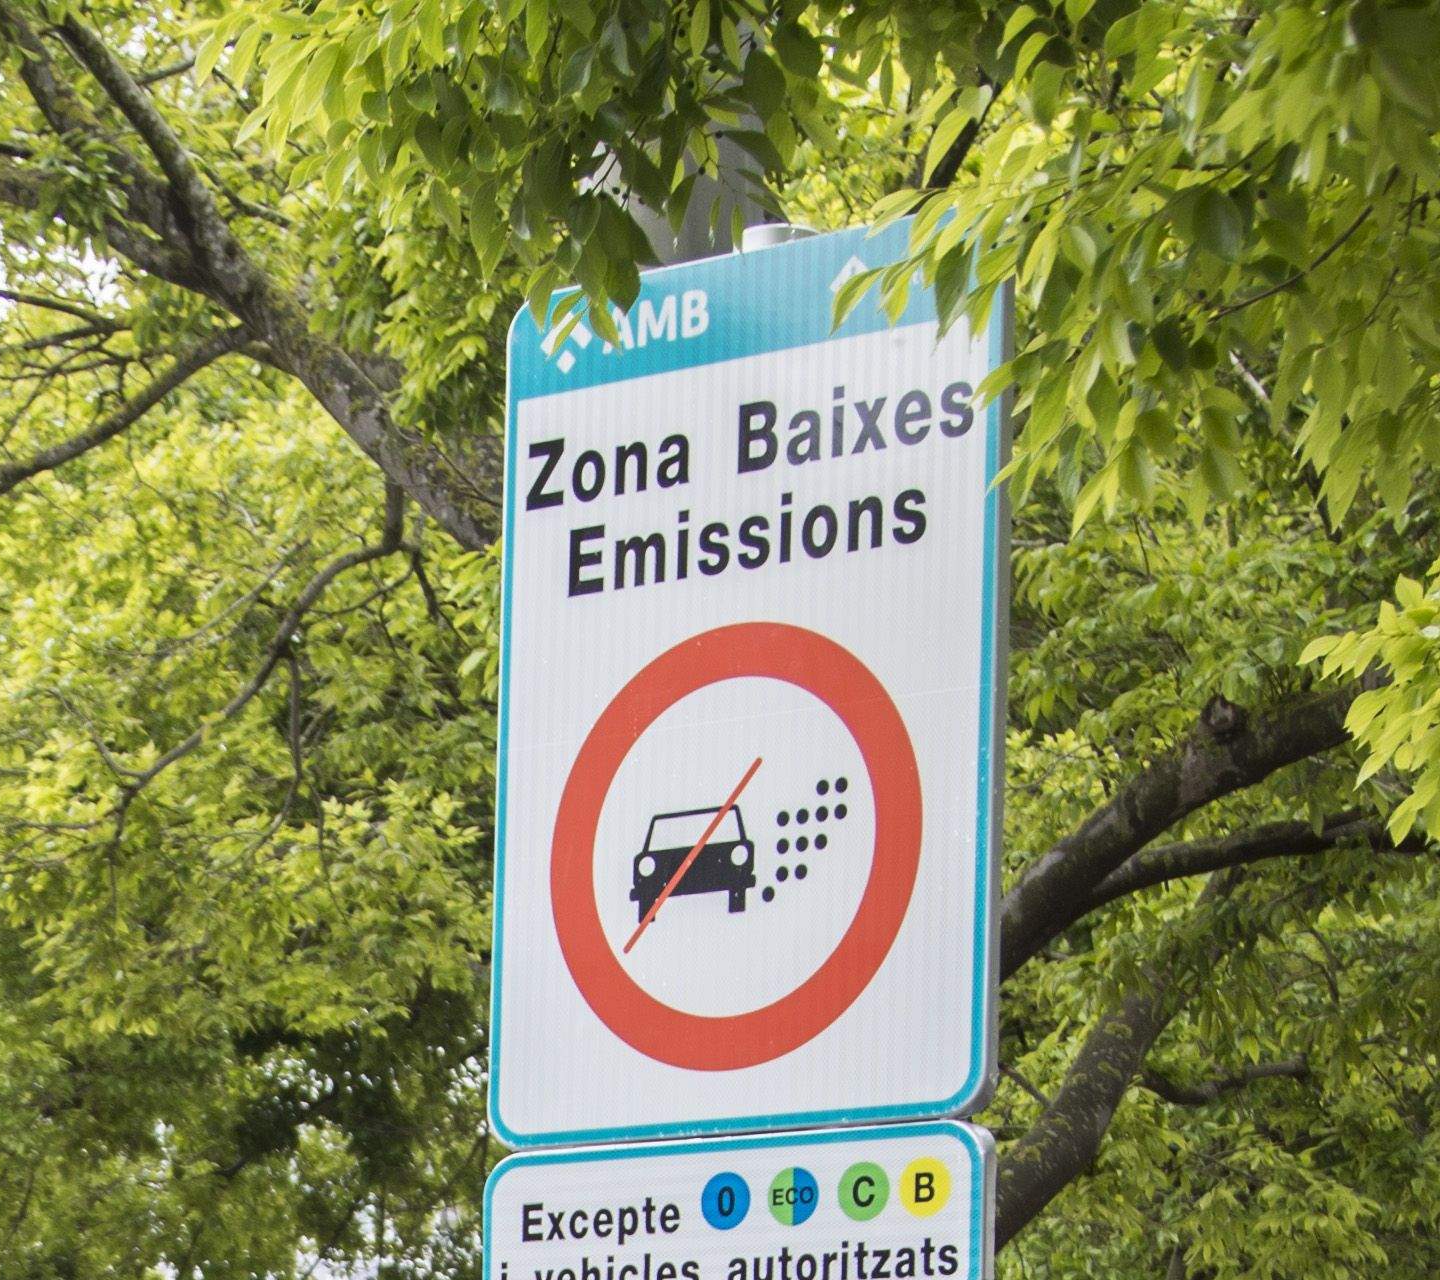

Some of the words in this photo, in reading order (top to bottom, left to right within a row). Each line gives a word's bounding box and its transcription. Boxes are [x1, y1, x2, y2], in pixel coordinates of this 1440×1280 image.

[525, 432, 690, 512] Zona
[737, 380, 975, 474] Baixes
[567, 488, 928, 598] Emissions
[521, 1197, 681, 1245] Excepte
[772, 1185, 814, 1207] ECO
[852, 1177, 876, 1208] C
[914, 1171, 936, 1204] B
